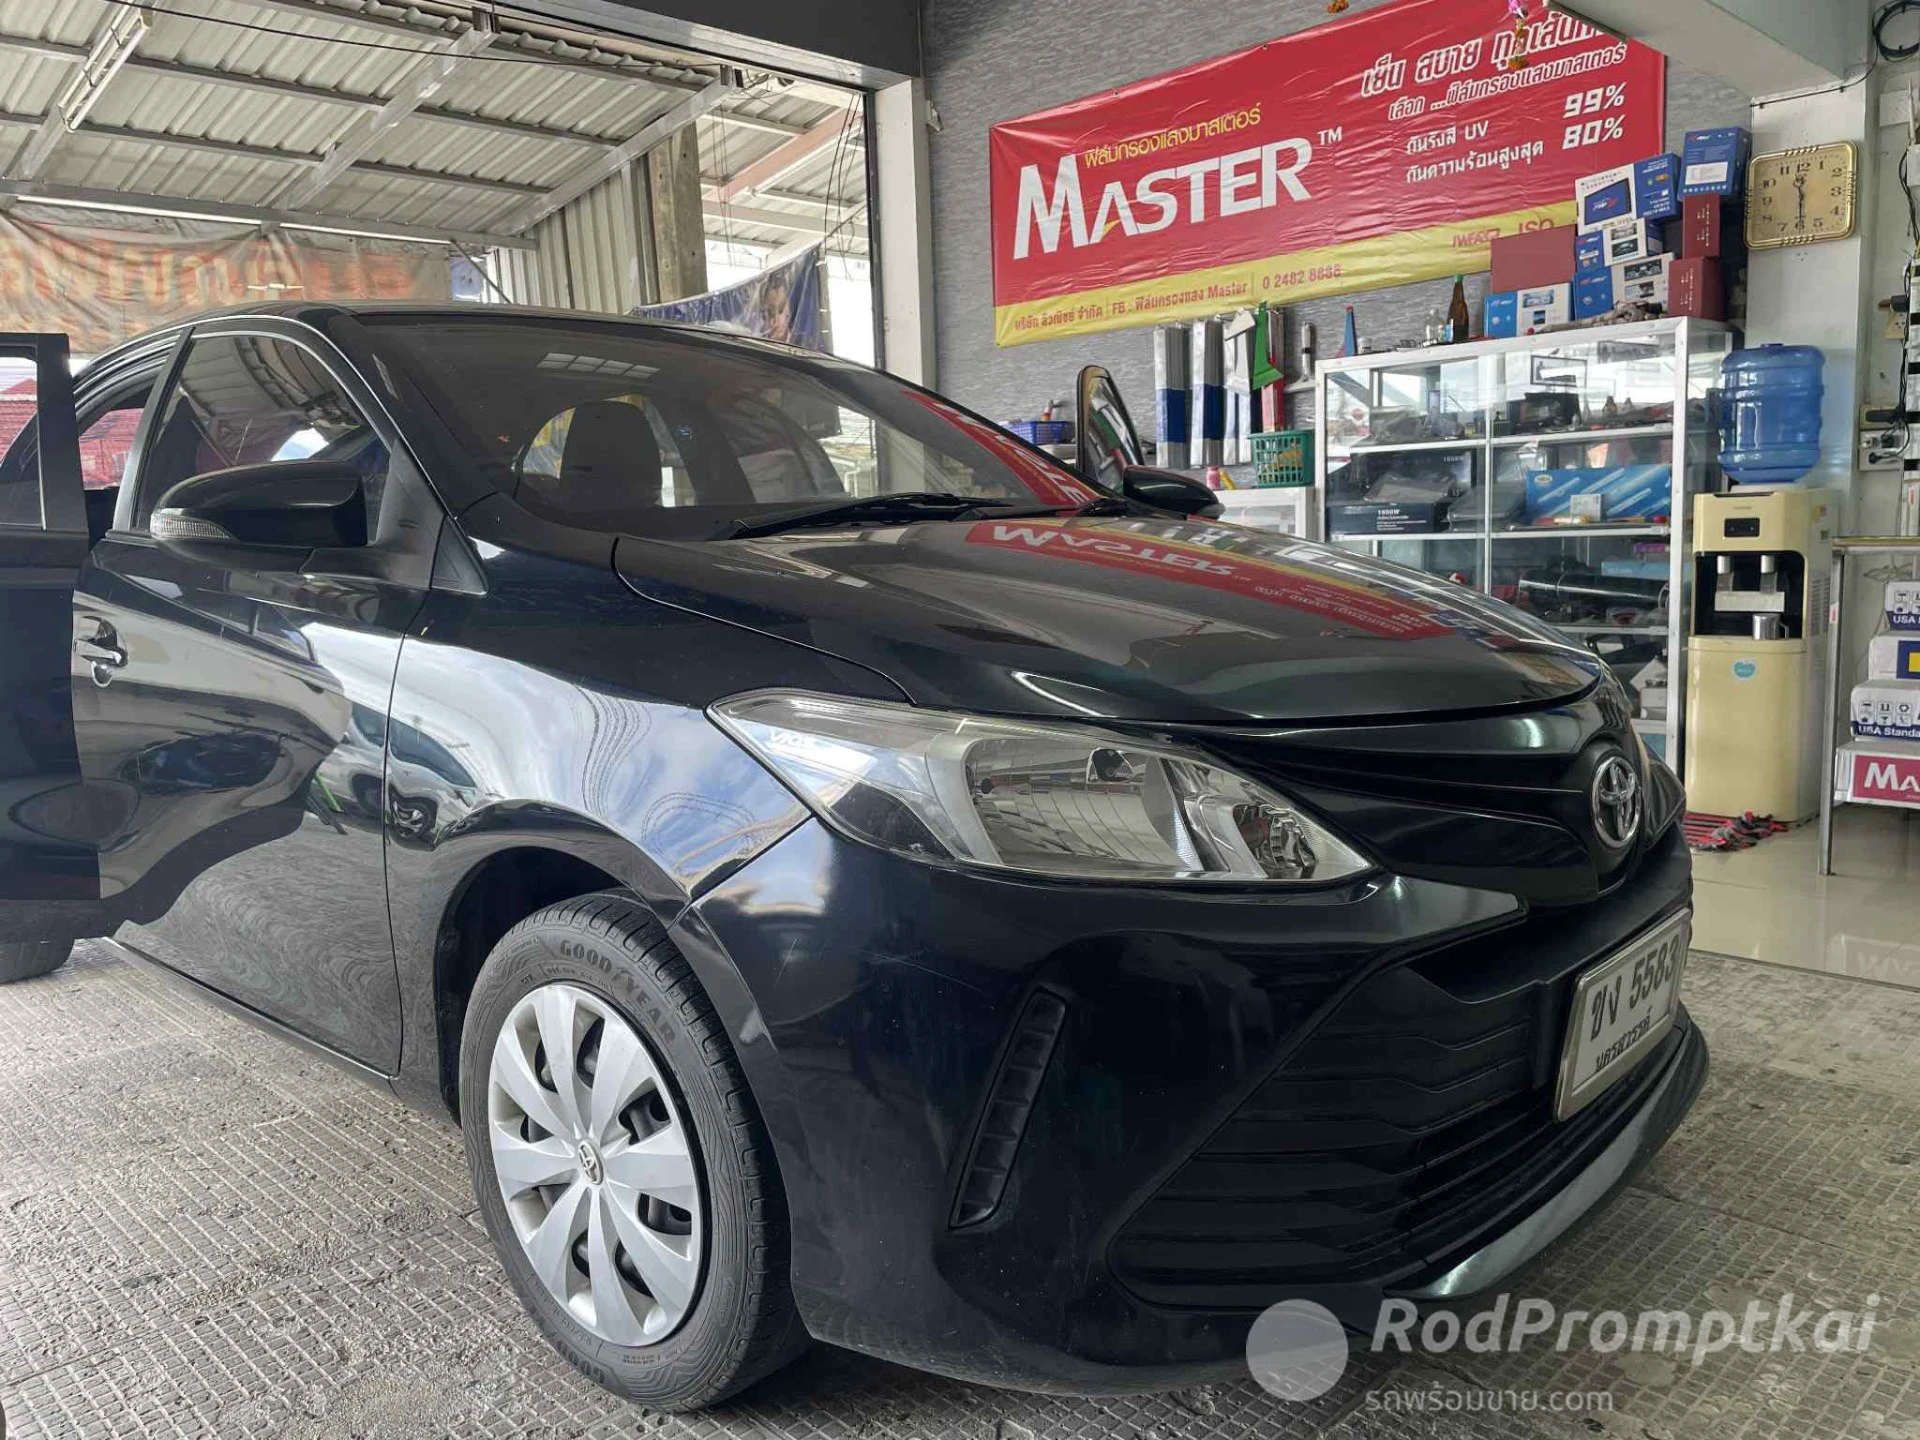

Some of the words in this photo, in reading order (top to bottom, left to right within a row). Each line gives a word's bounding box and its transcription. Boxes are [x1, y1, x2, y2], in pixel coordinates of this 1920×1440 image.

[1361, 53, 1406, 98] เย็น
[1414, 38, 1482, 83] สบาย
[1388, 94, 1425, 121] เลือก
[1406, 125, 1457, 155] กันรังสี
[1465, 120, 1489, 140] UV
[1563, 82, 1627, 119] 99%
[1085, 102, 1262, 169] ฟิล์มกรองแสงมาสเตอร์
[1406, 140, 1544, 184] กันความร้อนสูงสุด
[1561, 115, 1627, 151] 80%
[1780, 164, 1790, 175] 11
[1796, 162, 1811, 173] 12
[1818, 160, 1824, 170] 1
[1832, 167, 1842, 178] 2
[1762, 178, 1777, 188] 10
[1831, 186, 1842, 197] 3
[1013, 137, 1313, 260] MASTER
[1777, 222, 1787, 232] 7
[1813, 217, 1824, 228] 5
[1207, 282, 1248, 299] Master
[1893, 615, 1916, 625] USA
[1858, 725, 1882, 736] USA
[1629, 934, 1681, 1010] 5583
